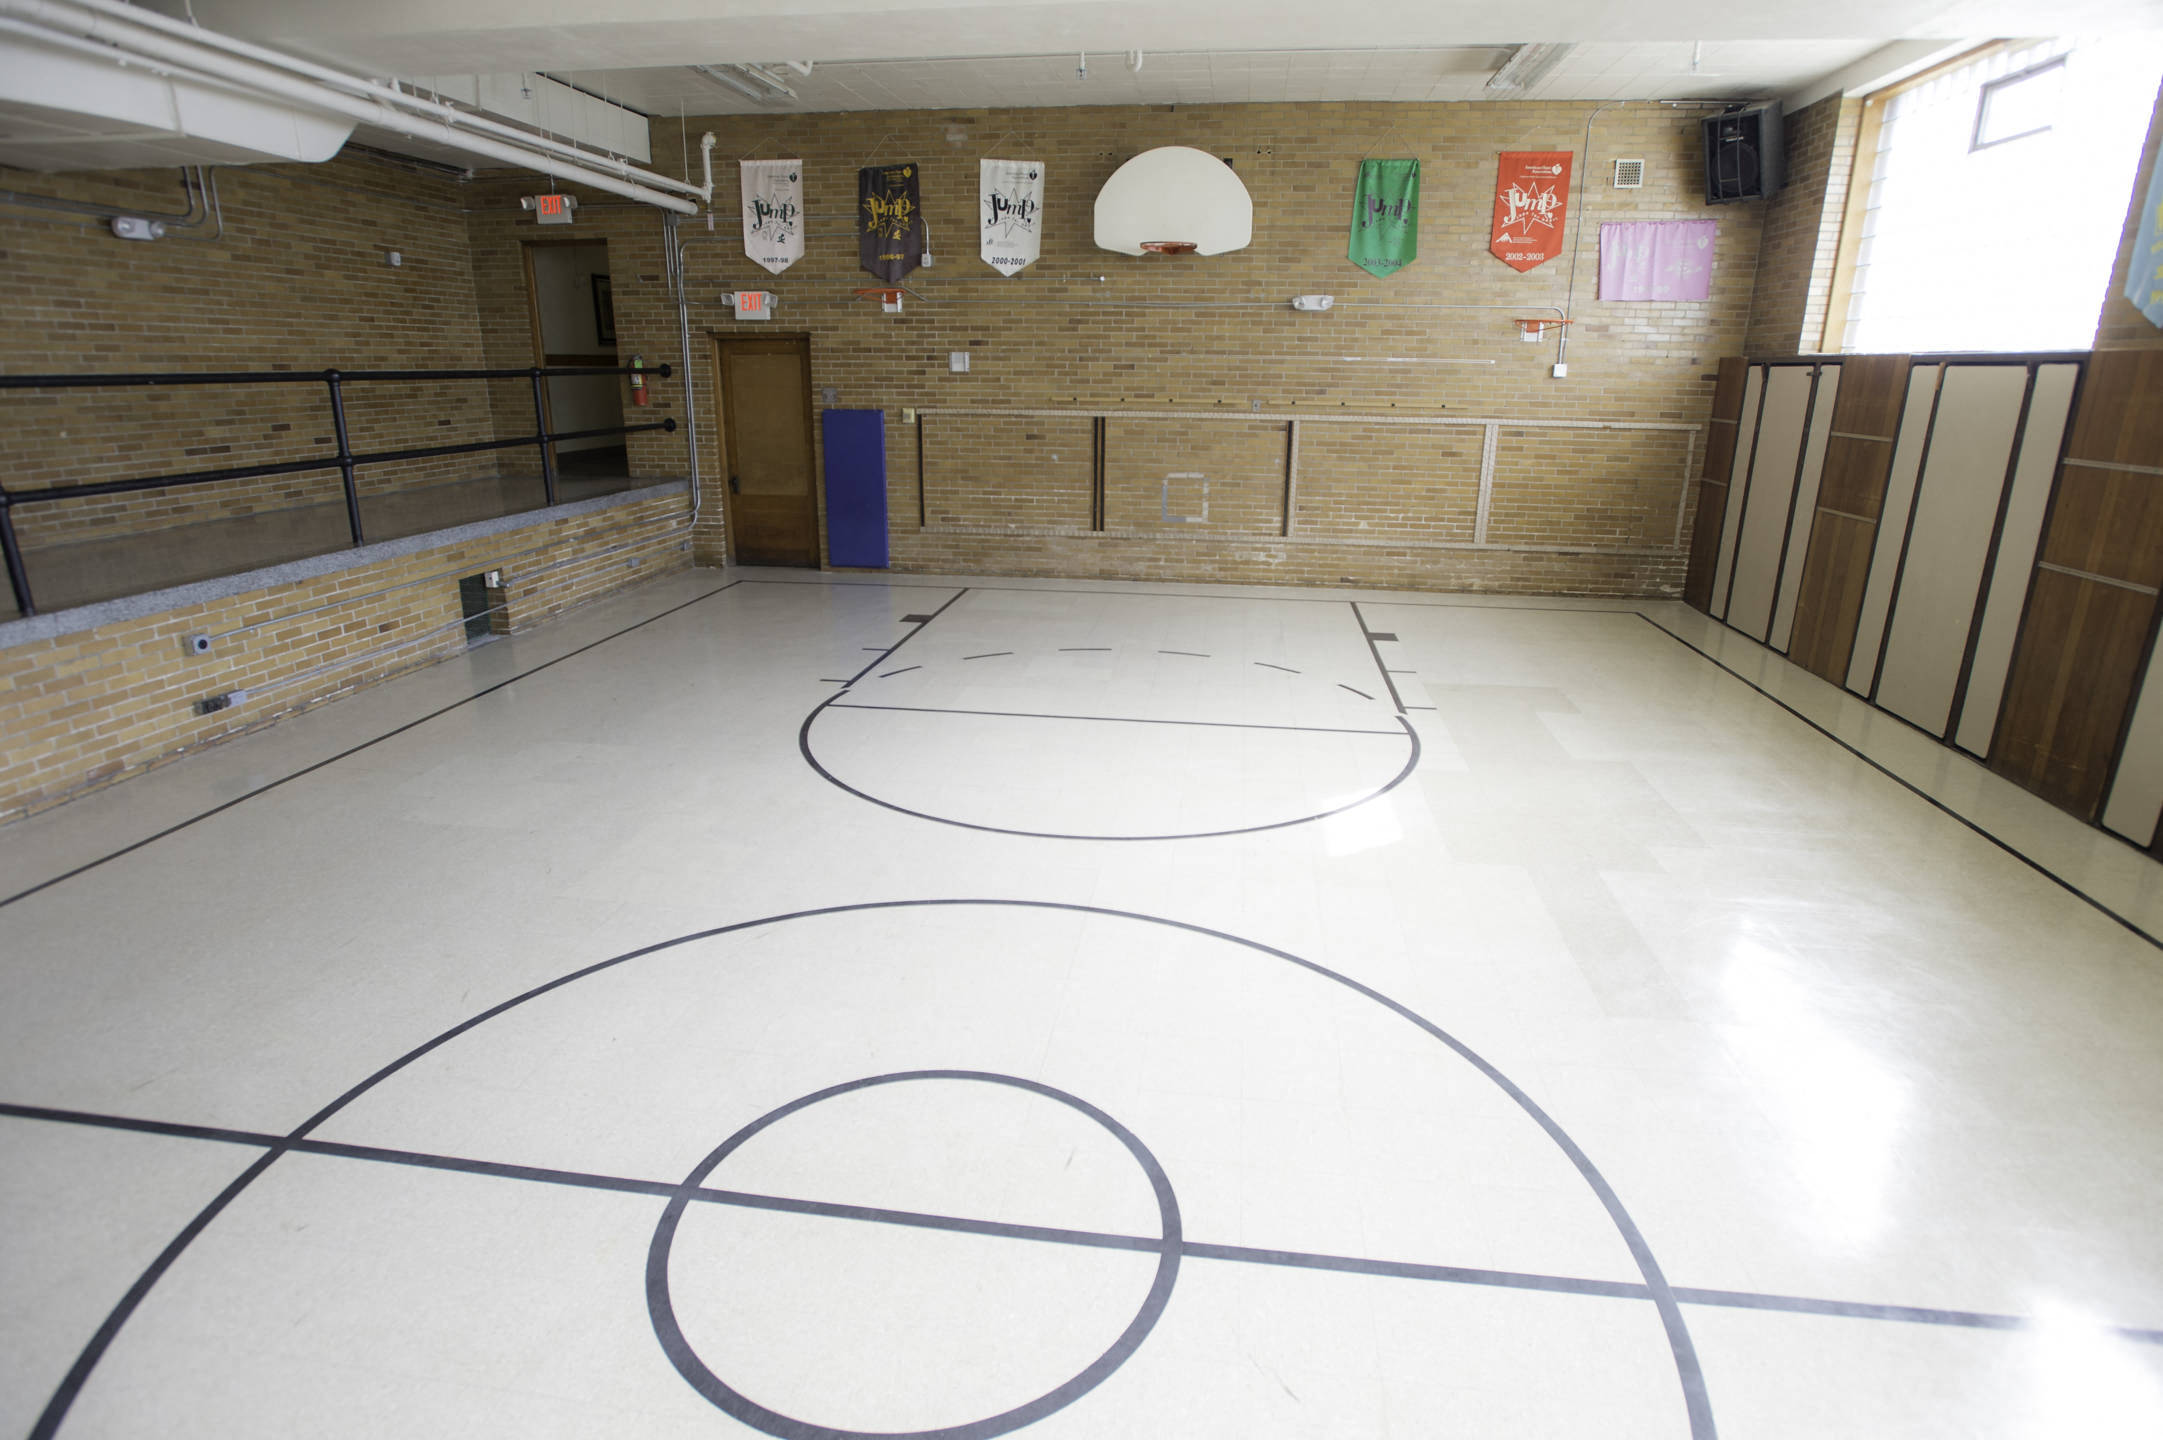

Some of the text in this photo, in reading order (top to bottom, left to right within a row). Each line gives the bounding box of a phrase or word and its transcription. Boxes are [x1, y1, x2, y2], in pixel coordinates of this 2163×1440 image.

[541, 195, 562, 215] EXIT
[992, 257, 1026, 266] 2000-2001
[741, 293, 762, 312] EXIT
